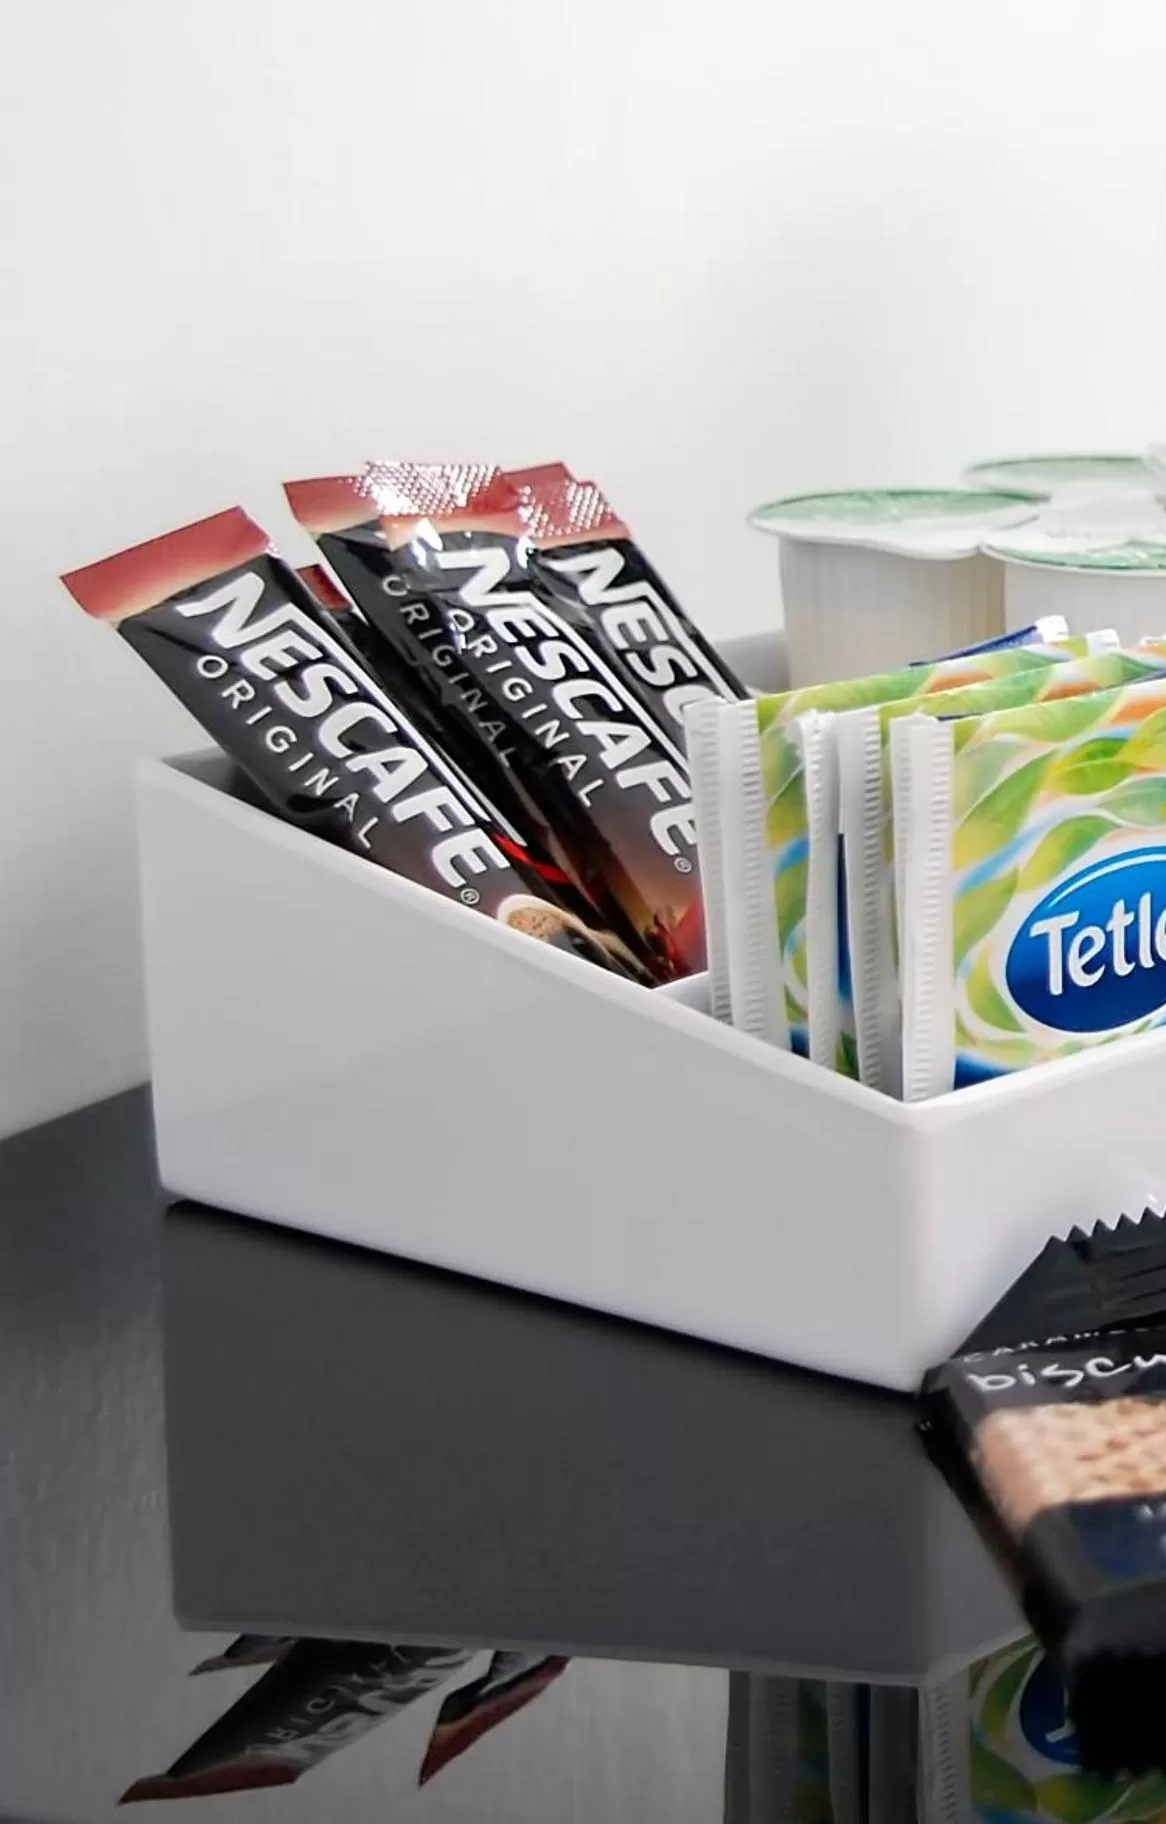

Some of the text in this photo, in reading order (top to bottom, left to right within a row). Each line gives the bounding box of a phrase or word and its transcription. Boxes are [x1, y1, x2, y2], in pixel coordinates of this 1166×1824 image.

[197, 654, 380, 849] ORIGINAL
[382, 575, 516, 768] ORIGINAL
[447, 608, 604, 808] ORIGINAL
